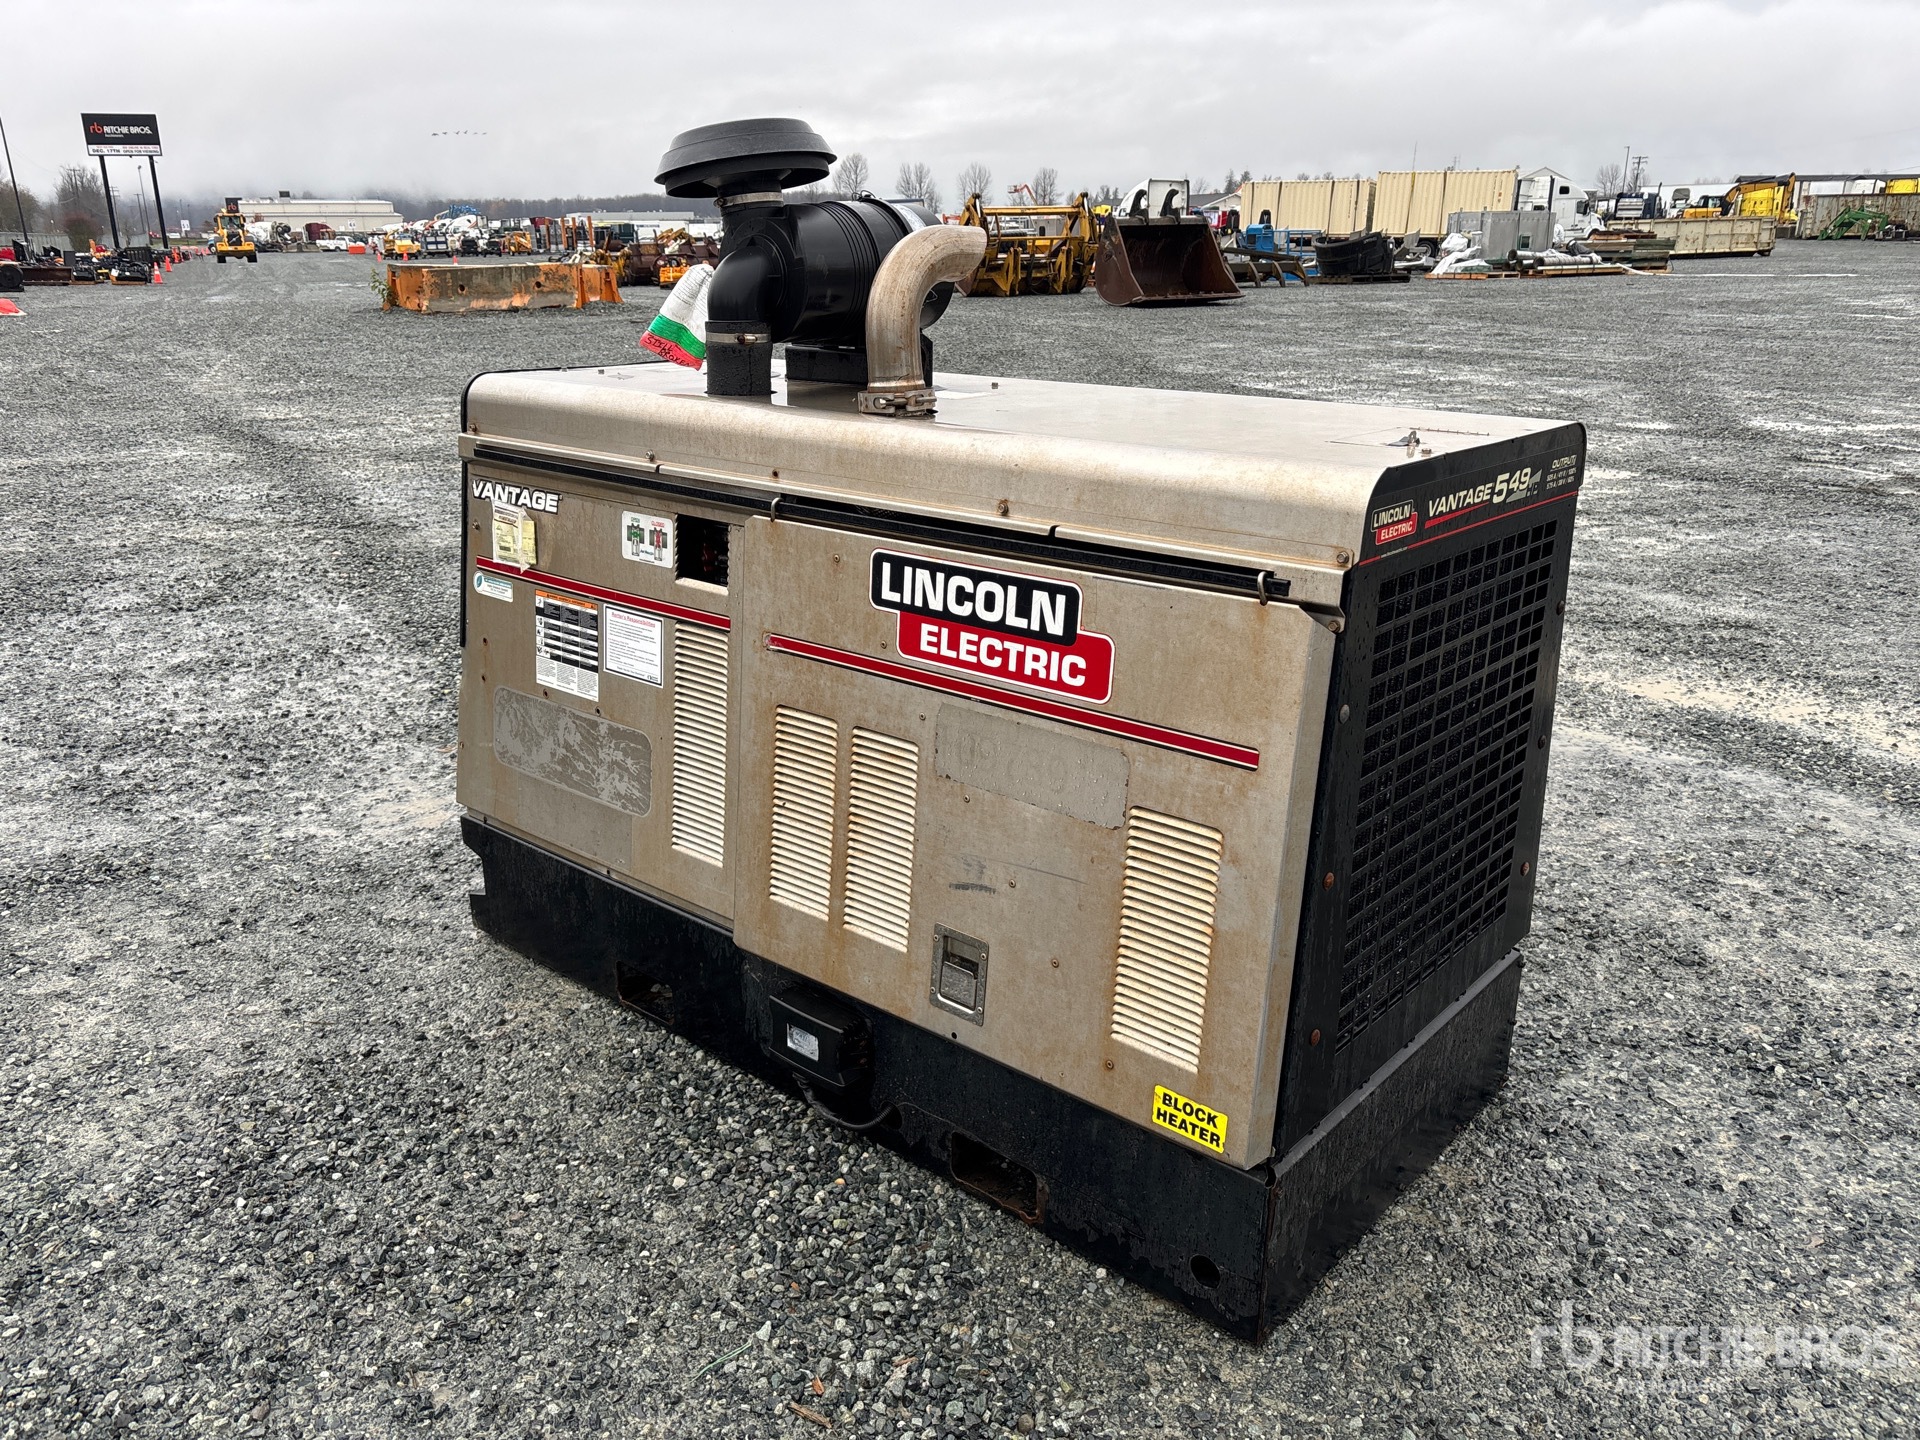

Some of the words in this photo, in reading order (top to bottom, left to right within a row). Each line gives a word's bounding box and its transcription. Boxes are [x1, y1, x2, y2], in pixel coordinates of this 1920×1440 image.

[103, 125, 130, 135] RITCHIE
[1551, 455, 1577, 469] OUTPUT
[472, 480, 560, 514] VANTAGE
[1429, 482, 1493, 517] VANTAGE
[1492, 467, 1532, 504] 549
[1373, 503, 1412, 528] LINCOLN
[1380, 521, 1414, 541] ELECTRIC
[881, 561, 1067, 637] LINCOLN
[920, 622, 1087, 688] ELECTRIC
[1156, 1106, 1221, 1148] HEATER
[1162, 1091, 1219, 1130] BLOCK
